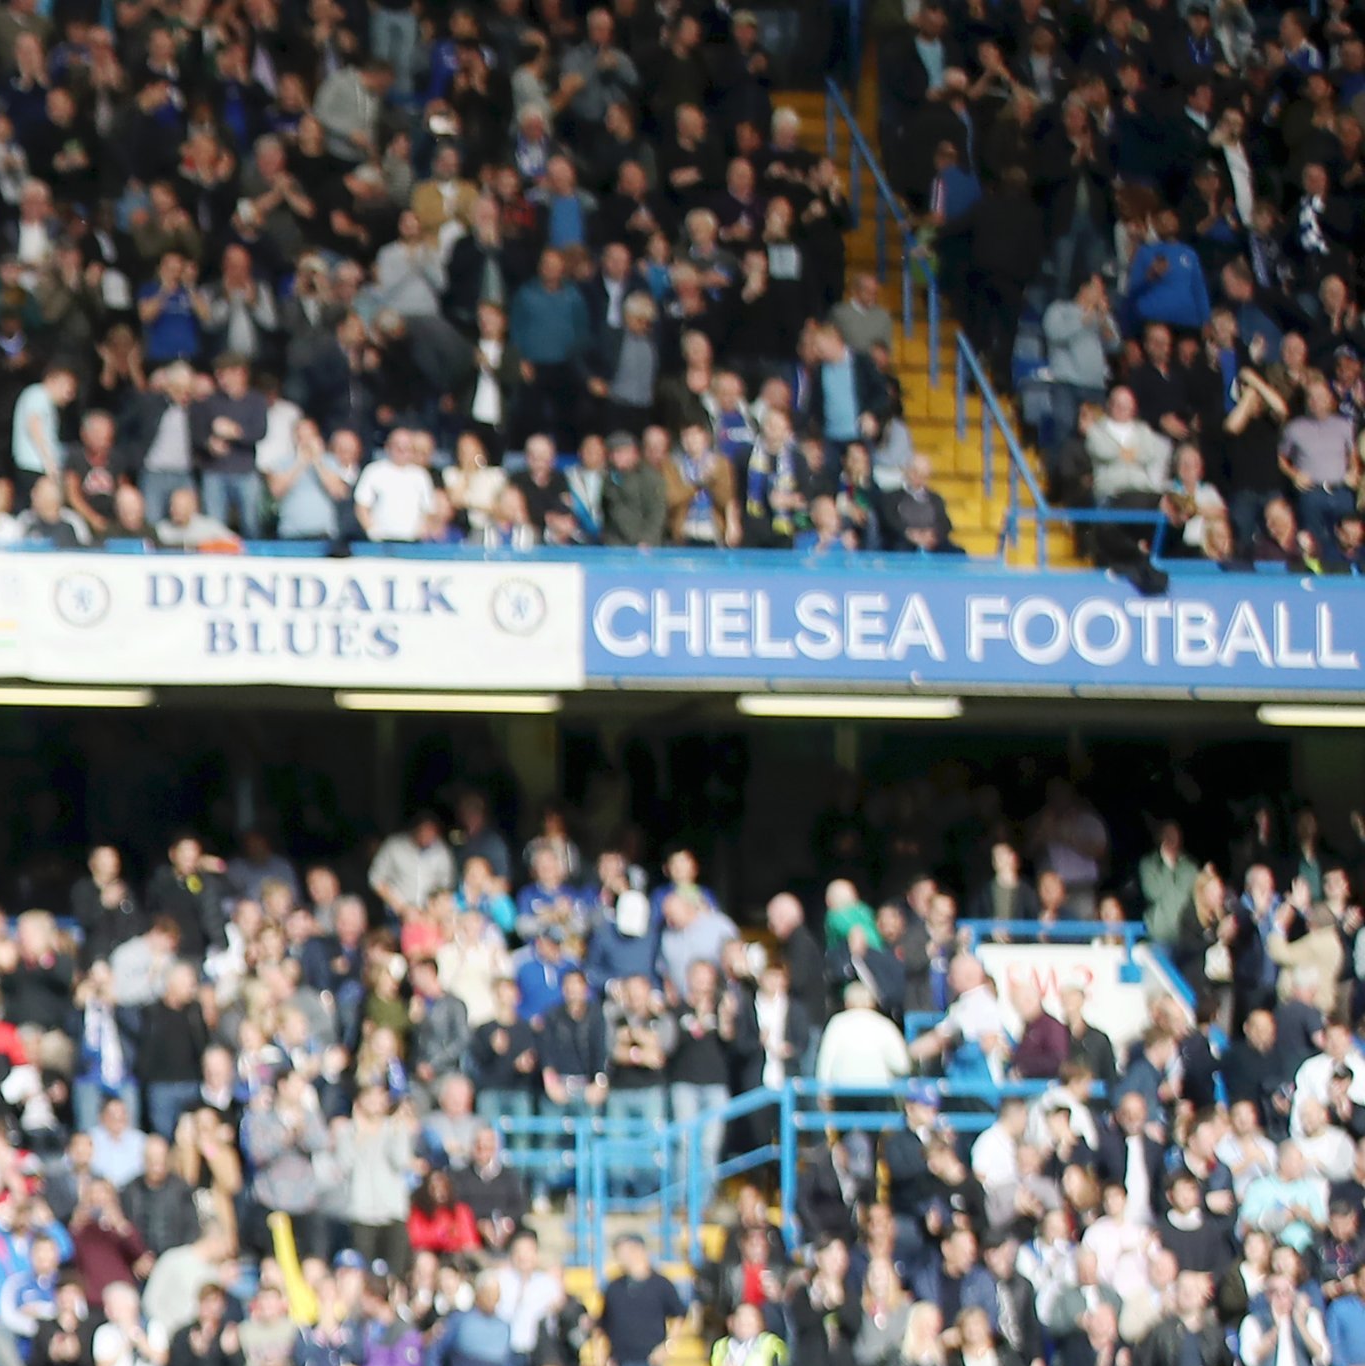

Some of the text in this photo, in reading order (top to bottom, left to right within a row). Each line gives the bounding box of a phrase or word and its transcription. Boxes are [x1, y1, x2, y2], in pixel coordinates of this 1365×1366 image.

[146, 572, 459, 615] DUNDALK
[206, 621, 401, 658] BLUES
[592, 588, 1361, 669] CHELSEA FOOTBALL
